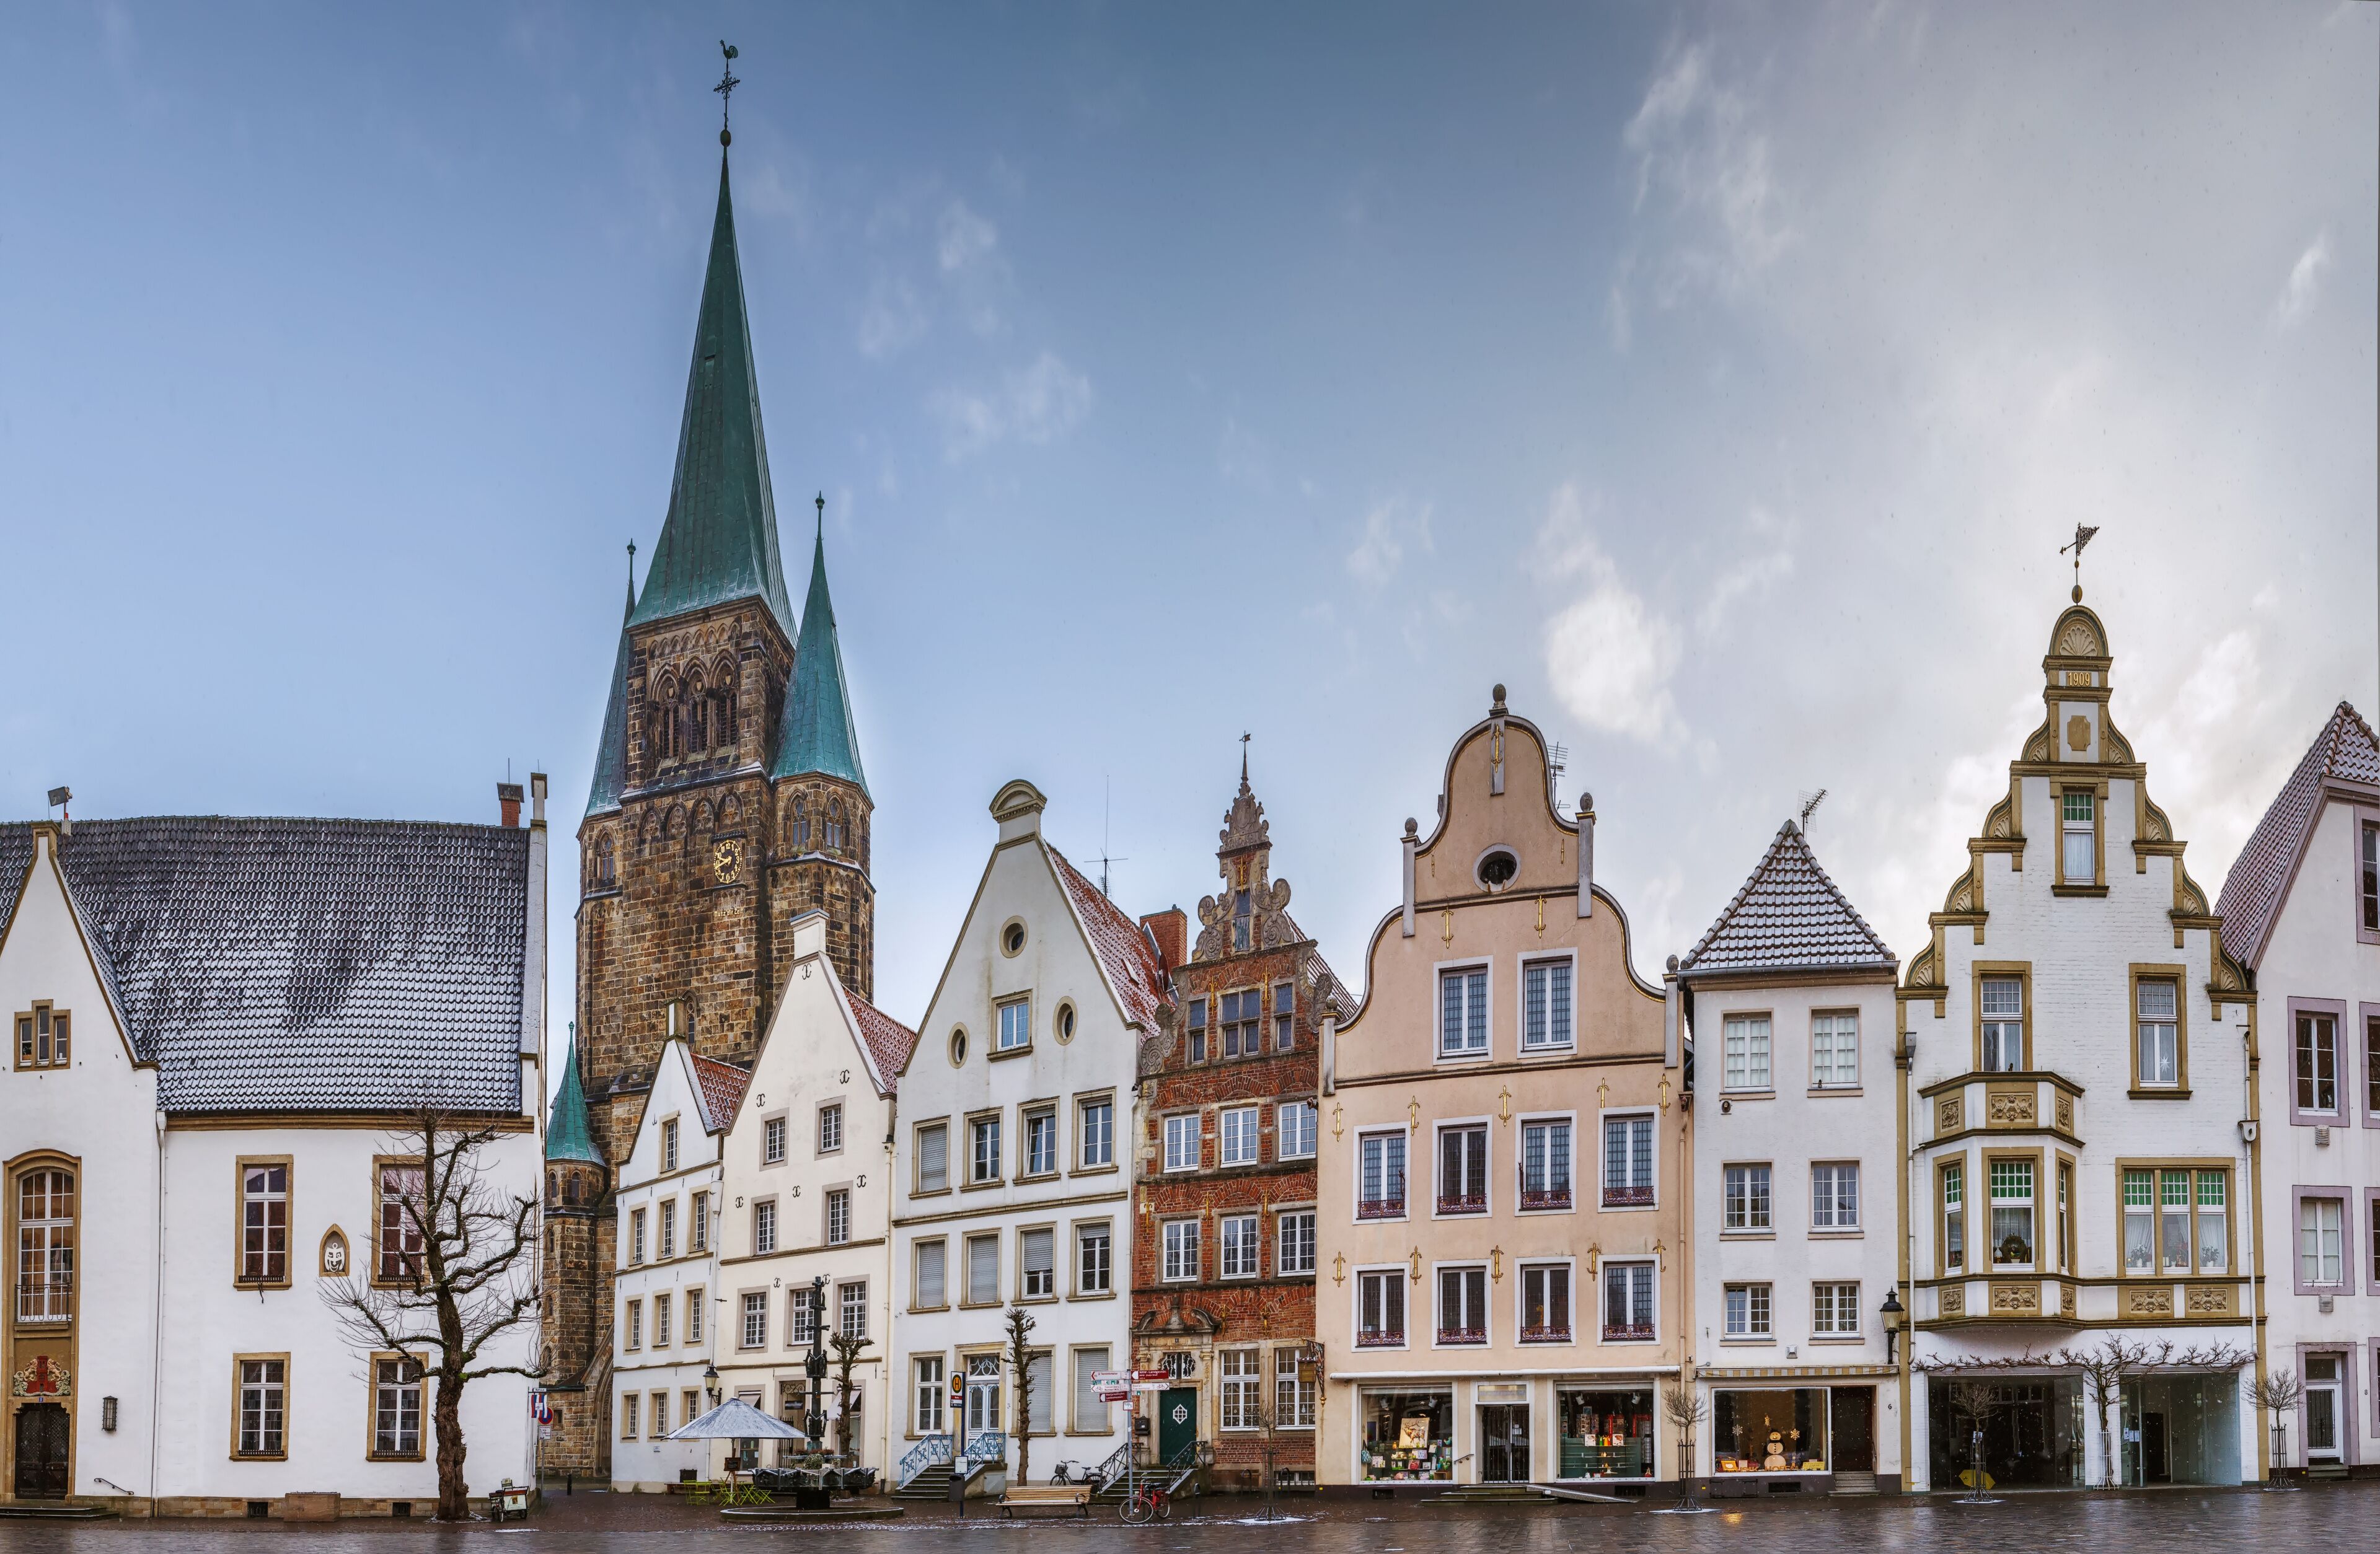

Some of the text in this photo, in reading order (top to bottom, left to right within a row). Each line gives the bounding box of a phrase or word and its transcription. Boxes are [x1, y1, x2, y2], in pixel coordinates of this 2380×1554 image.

[2068, 672, 2090, 686] 1909
[736, 856, 739, 864] 3
[734, 864, 738, 872] 4
[731, 870, 735, 879] 5
[955, 1377, 959, 1389] H
